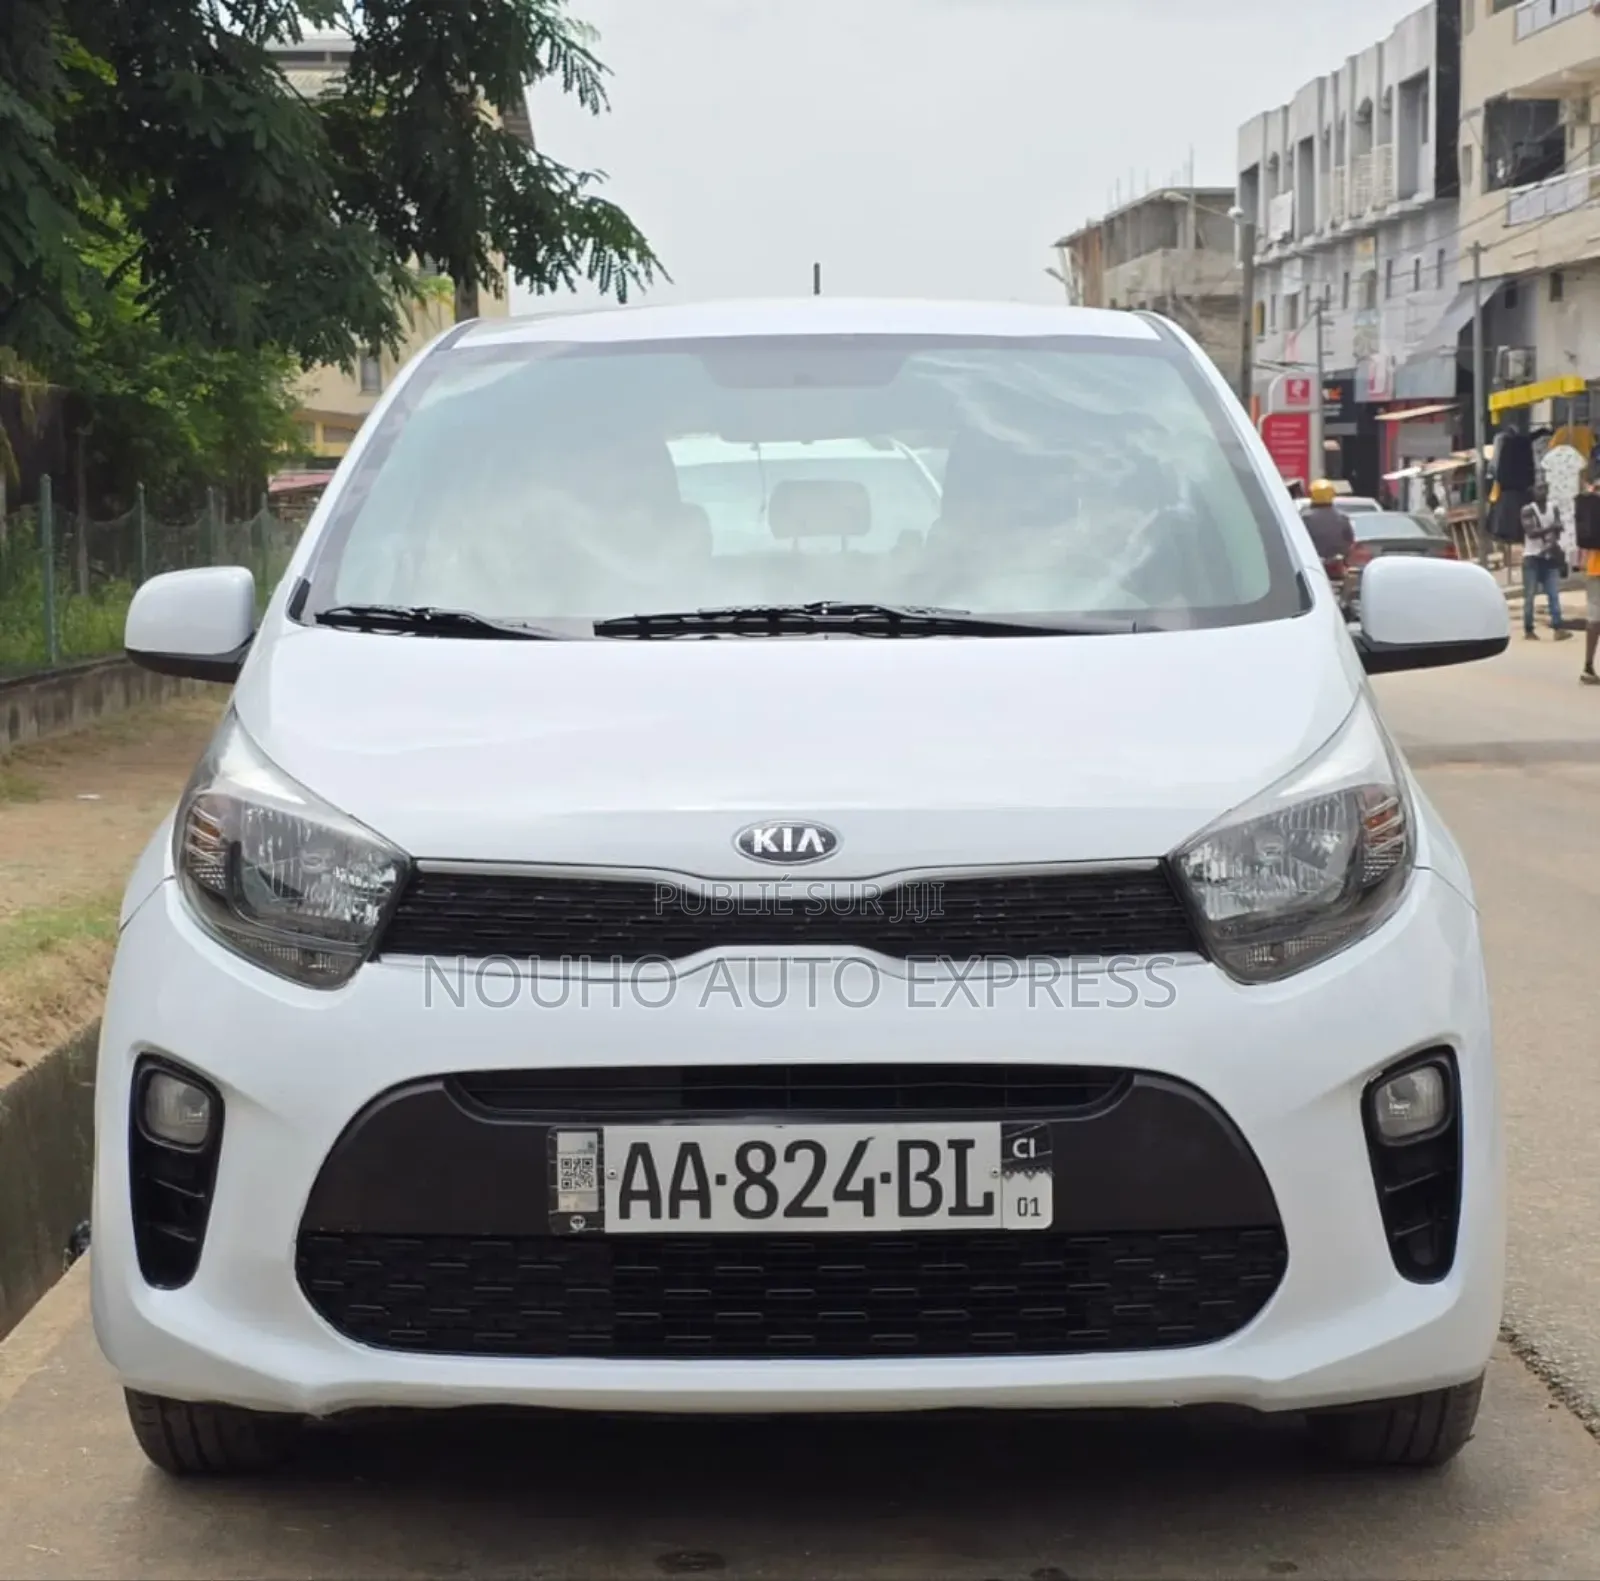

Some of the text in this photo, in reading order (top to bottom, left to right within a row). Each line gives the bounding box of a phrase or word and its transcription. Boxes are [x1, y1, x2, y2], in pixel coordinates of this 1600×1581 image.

[752, 827, 825, 853] KIA
[1012, 1138, 1036, 1158] CI
[1017, 1197, 1042, 1217] 01
